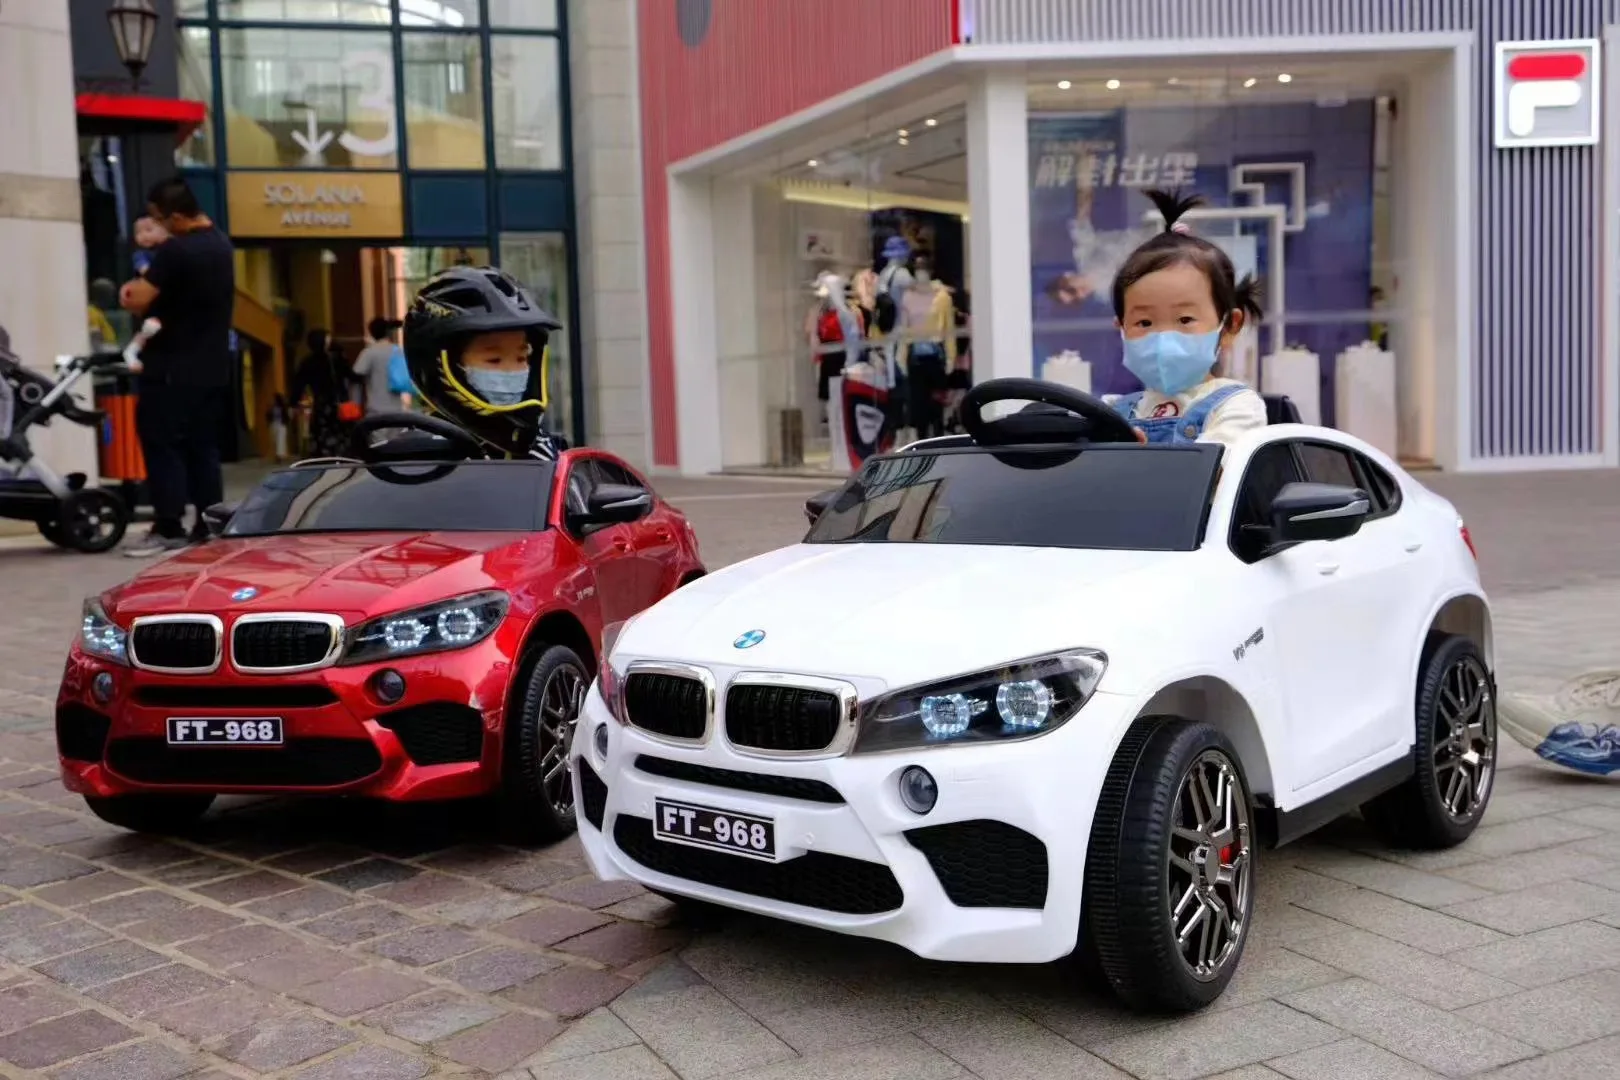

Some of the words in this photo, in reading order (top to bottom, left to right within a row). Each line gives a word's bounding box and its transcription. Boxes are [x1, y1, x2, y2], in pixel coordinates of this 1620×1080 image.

[338, 50, 398, 156] 3
[264, 184, 364, 205] SOLANA
[281, 211, 351, 226] AVENUE
[176, 721, 274, 740] FT-968
[663, 806, 767, 850] FT-968
